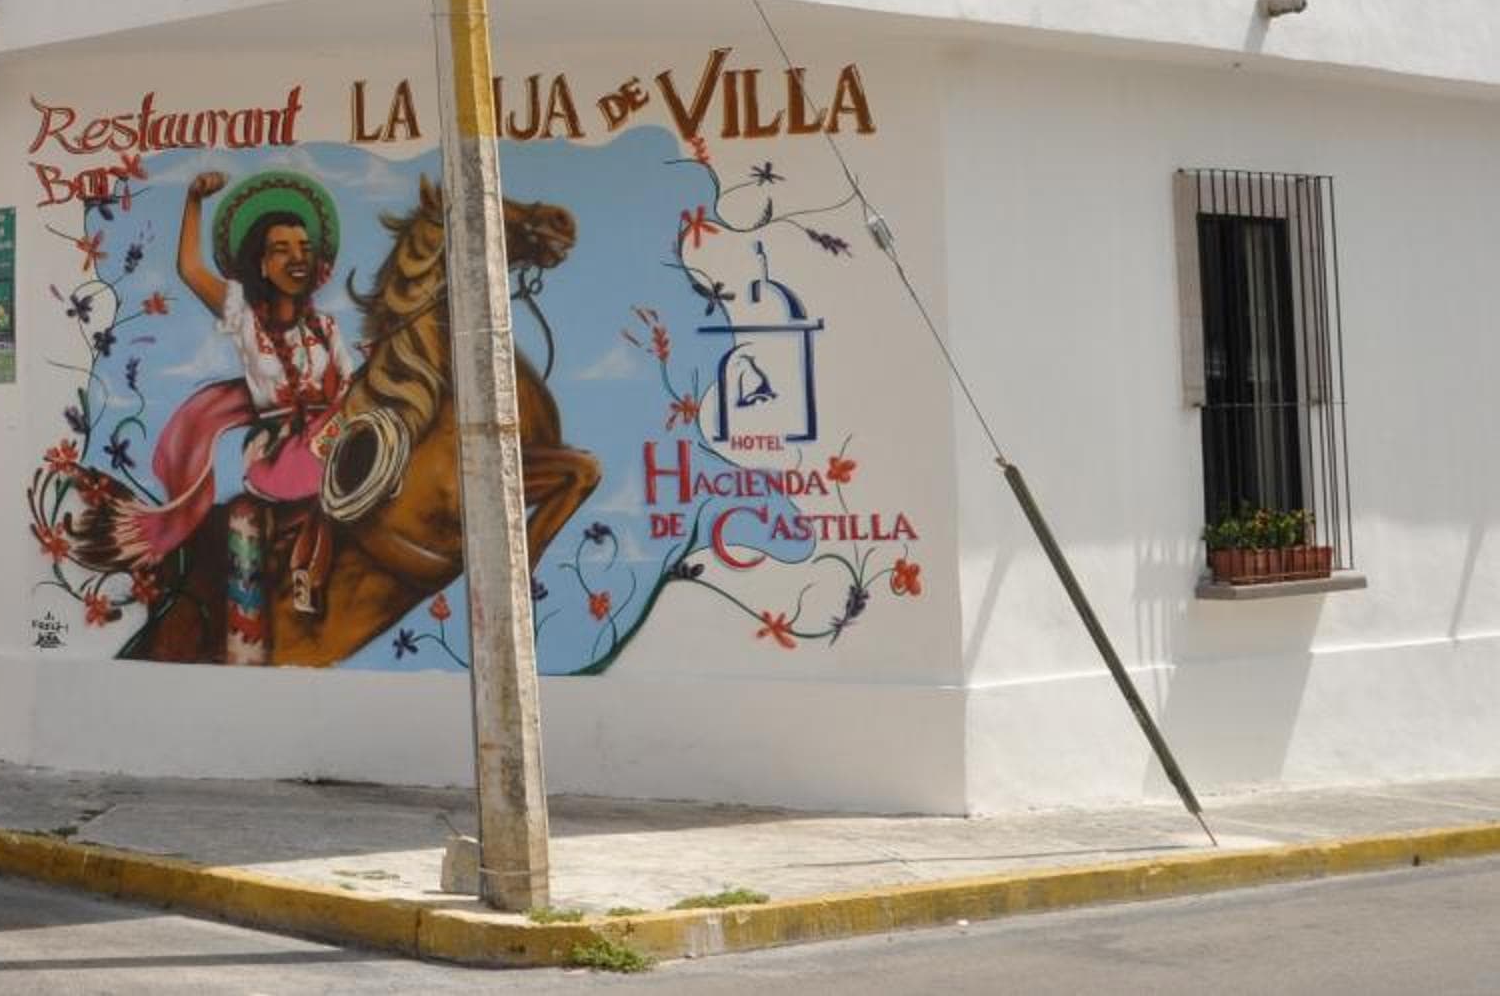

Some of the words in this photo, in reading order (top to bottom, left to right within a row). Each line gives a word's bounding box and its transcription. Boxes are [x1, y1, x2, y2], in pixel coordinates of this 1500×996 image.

[28, 84, 303, 154] Restaurant
[349, 77, 421, 142] LA
[493, 72, 585, 140] IJA
[596, 76, 650, 133] DE
[653, 46, 876, 142] VILLA
[643, 438, 829, 505] HACIENDA
[730, 434, 785, 452] HOTEL
[650, 513, 688, 540] DE
[712, 505, 919, 569] CASTILLA
